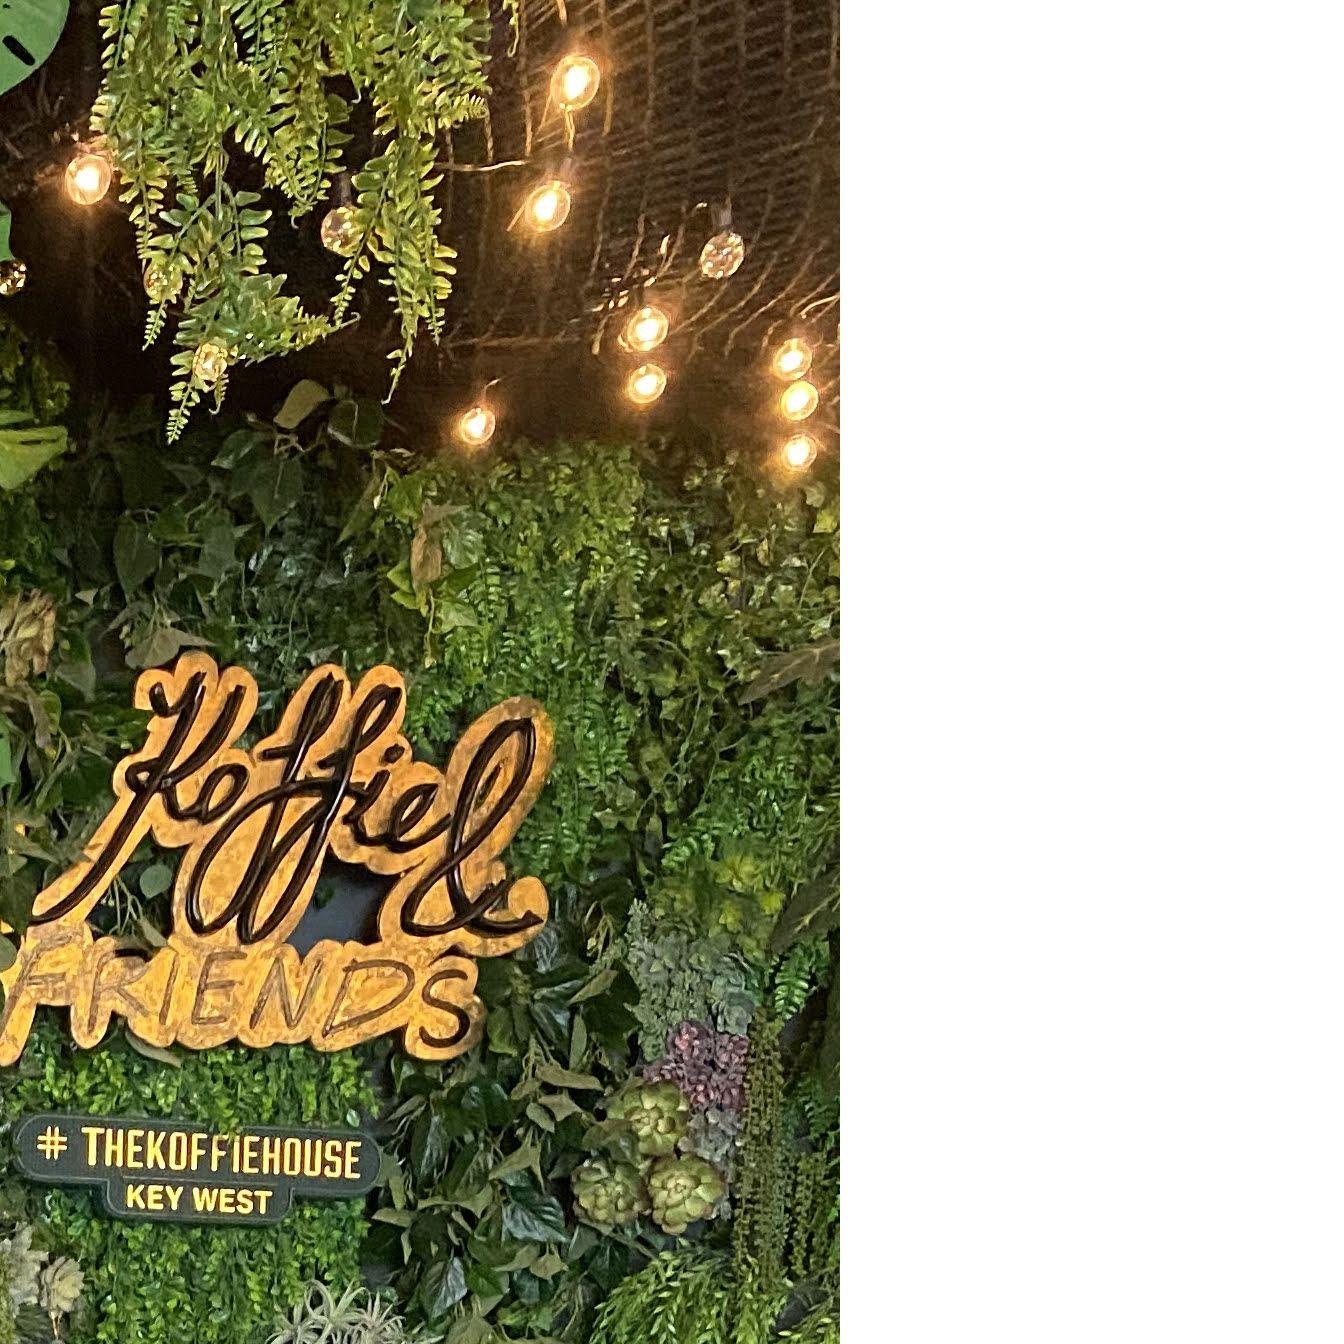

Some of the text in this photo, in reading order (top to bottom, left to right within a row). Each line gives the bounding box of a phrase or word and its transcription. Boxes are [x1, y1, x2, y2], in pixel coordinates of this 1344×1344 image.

[80, 1126, 363, 1180] THEKOFFIEHOUSE
[126, 1183, 274, 1215] KEY WEST
